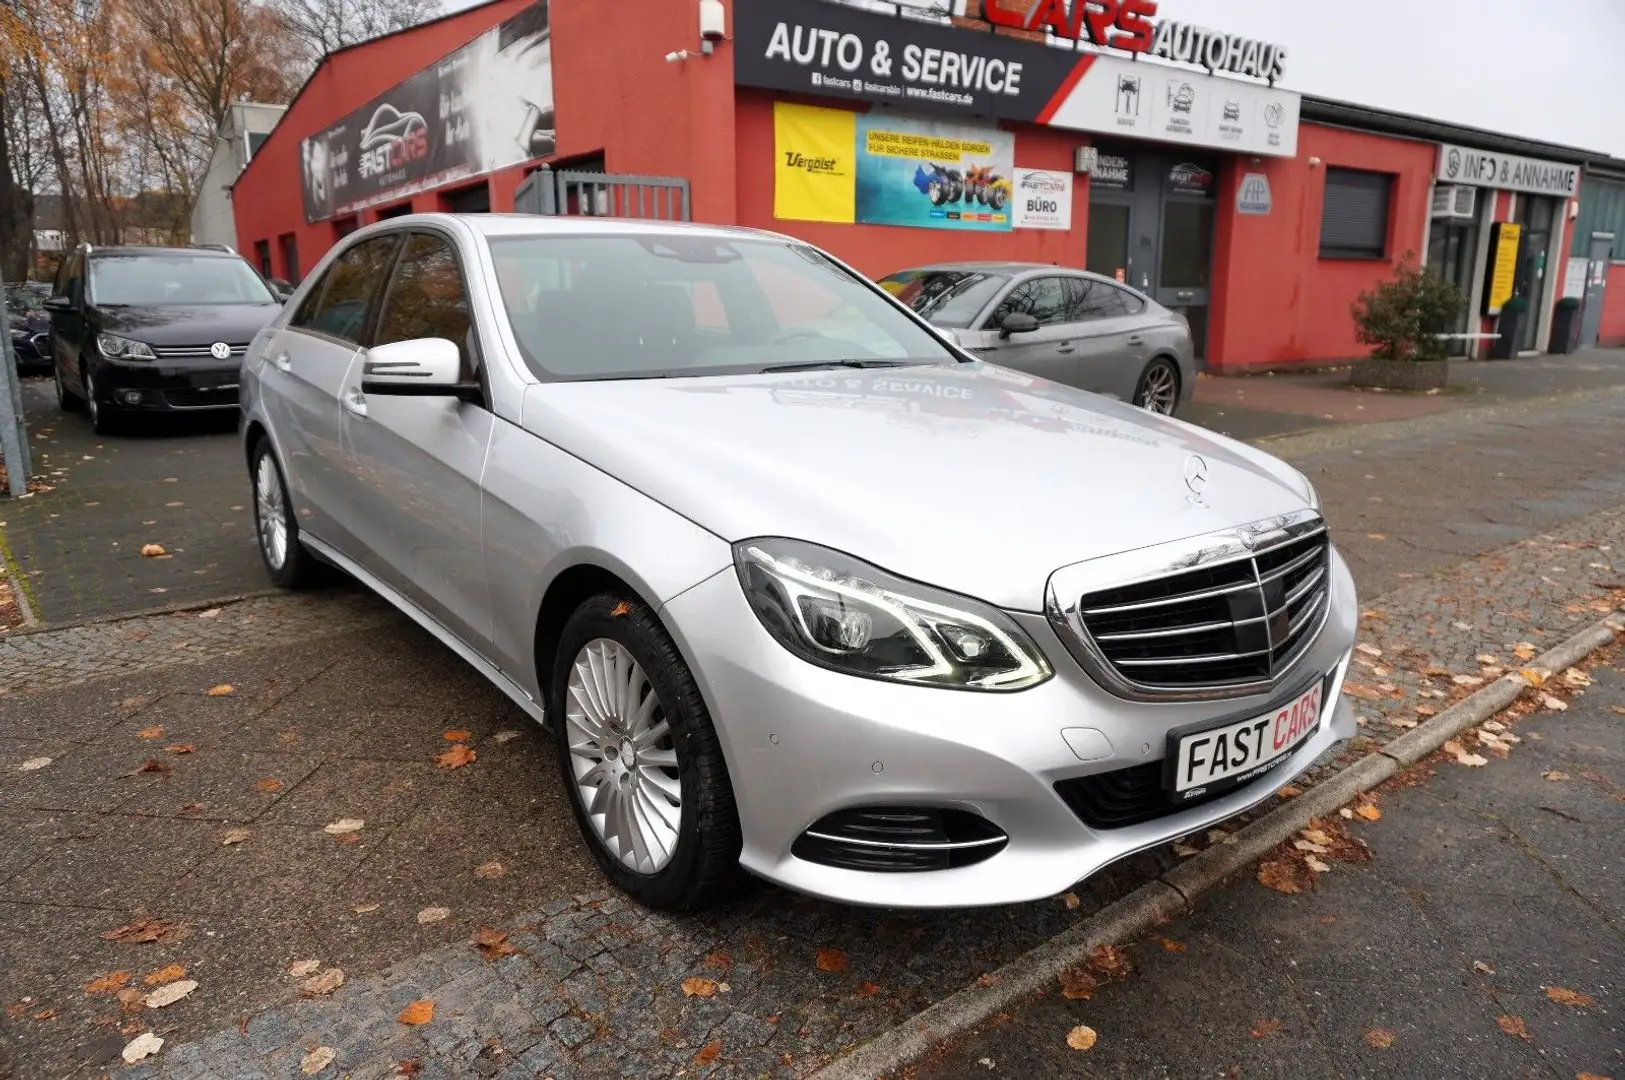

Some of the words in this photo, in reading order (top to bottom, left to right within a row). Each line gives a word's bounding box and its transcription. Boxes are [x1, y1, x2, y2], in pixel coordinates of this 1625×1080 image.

[764, 22, 863, 71] AUTO
[871, 40, 893, 77] &
[901, 44, 1023, 96] SERVICE
[1152, 19, 1287, 81] AUTOHAUS
[906, 86, 974, 105] www.fastcars.de
[869, 130, 901, 143] UNSERE
[1464, 154, 1497, 181] INFO
[1500, 160, 1510, 183] &
[1512, 162, 1576, 192] ANNAHME
[1026, 196, 1058, 213] BÜRO
[1187, 718, 1270, 783] FAST
[1273, 686, 1319, 751] CARS
